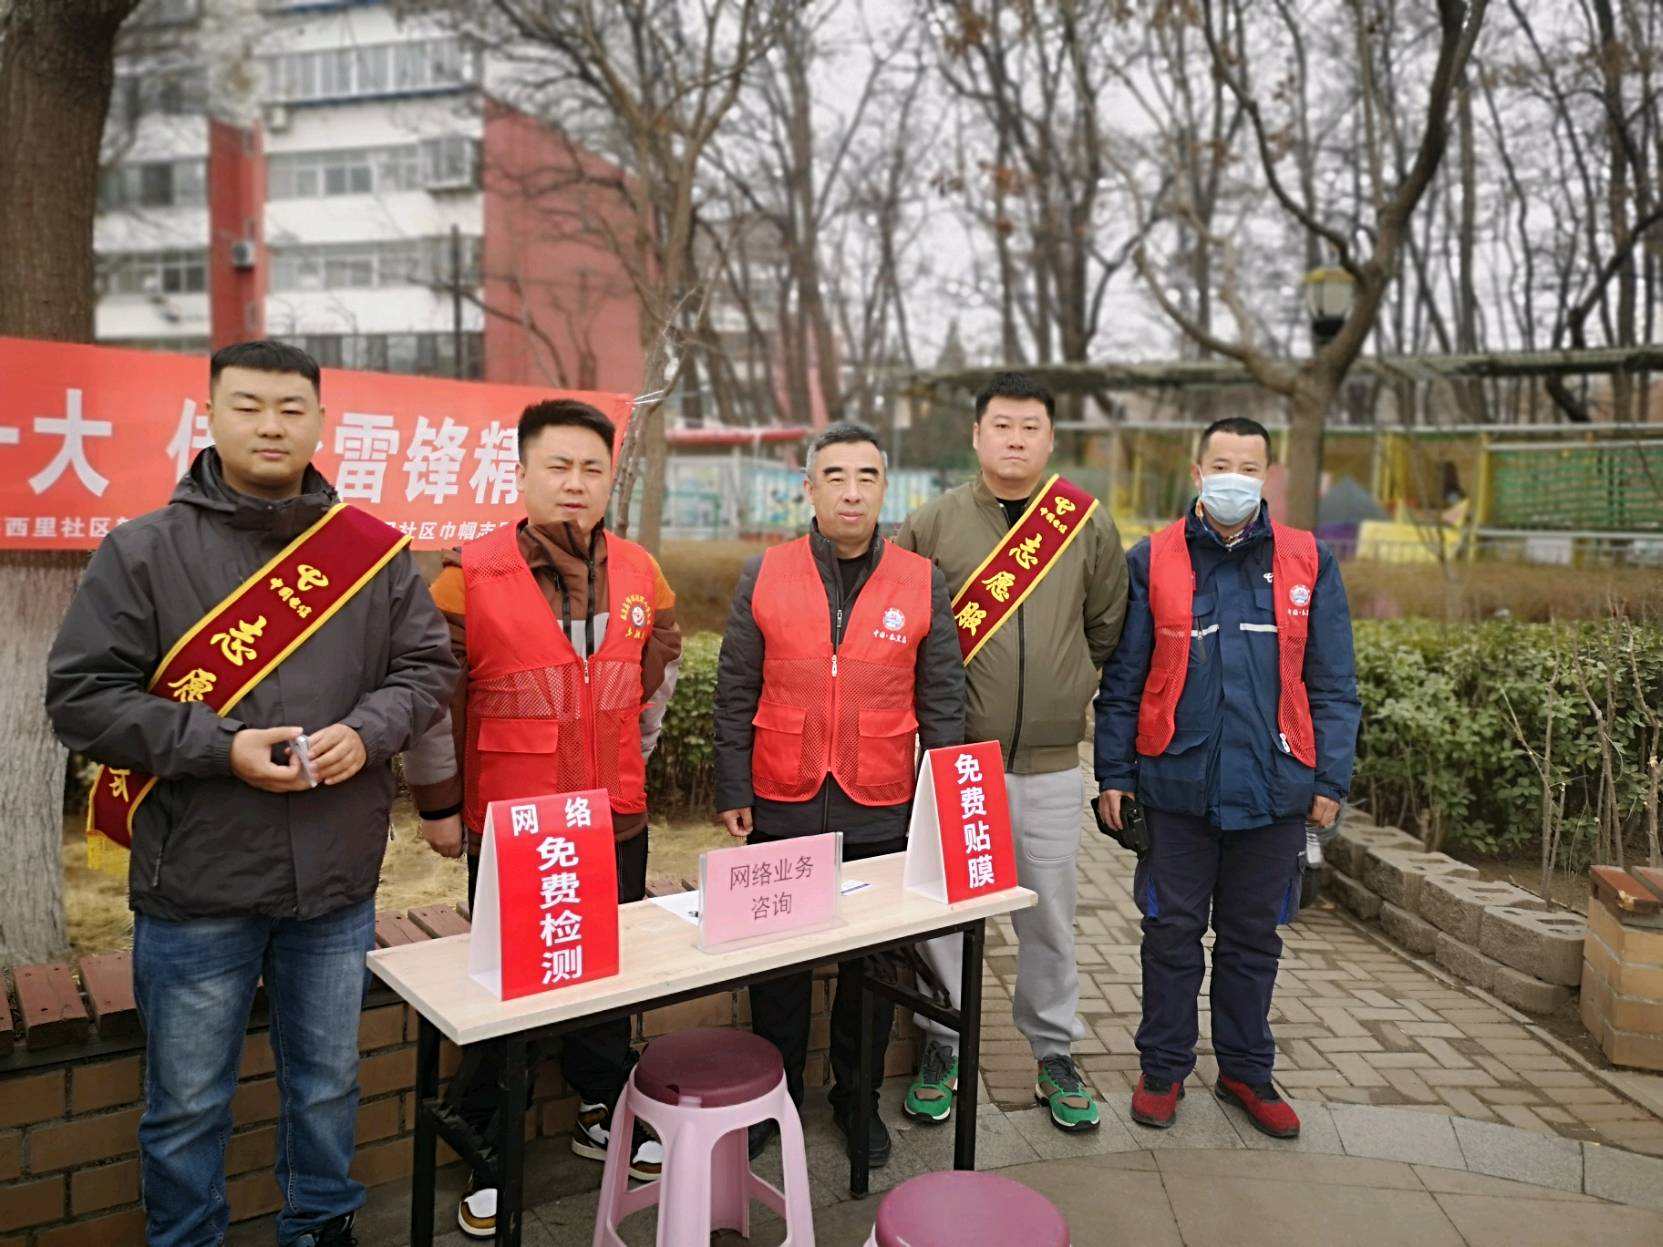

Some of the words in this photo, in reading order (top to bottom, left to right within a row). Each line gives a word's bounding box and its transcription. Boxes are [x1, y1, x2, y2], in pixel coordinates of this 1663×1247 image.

[0, 389, 112, 497] 大
[5, 515, 131, 538] 西里社区
[384, 520, 509, 541] 社区巾帼志
[510, 796, 592, 837] 网络
[954, 753, 995, 889] 免费贴膜
[729, 854, 815, 891] 网络业务
[535, 835, 583, 985] 免费检测
[751, 891, 793, 921] 咨询
